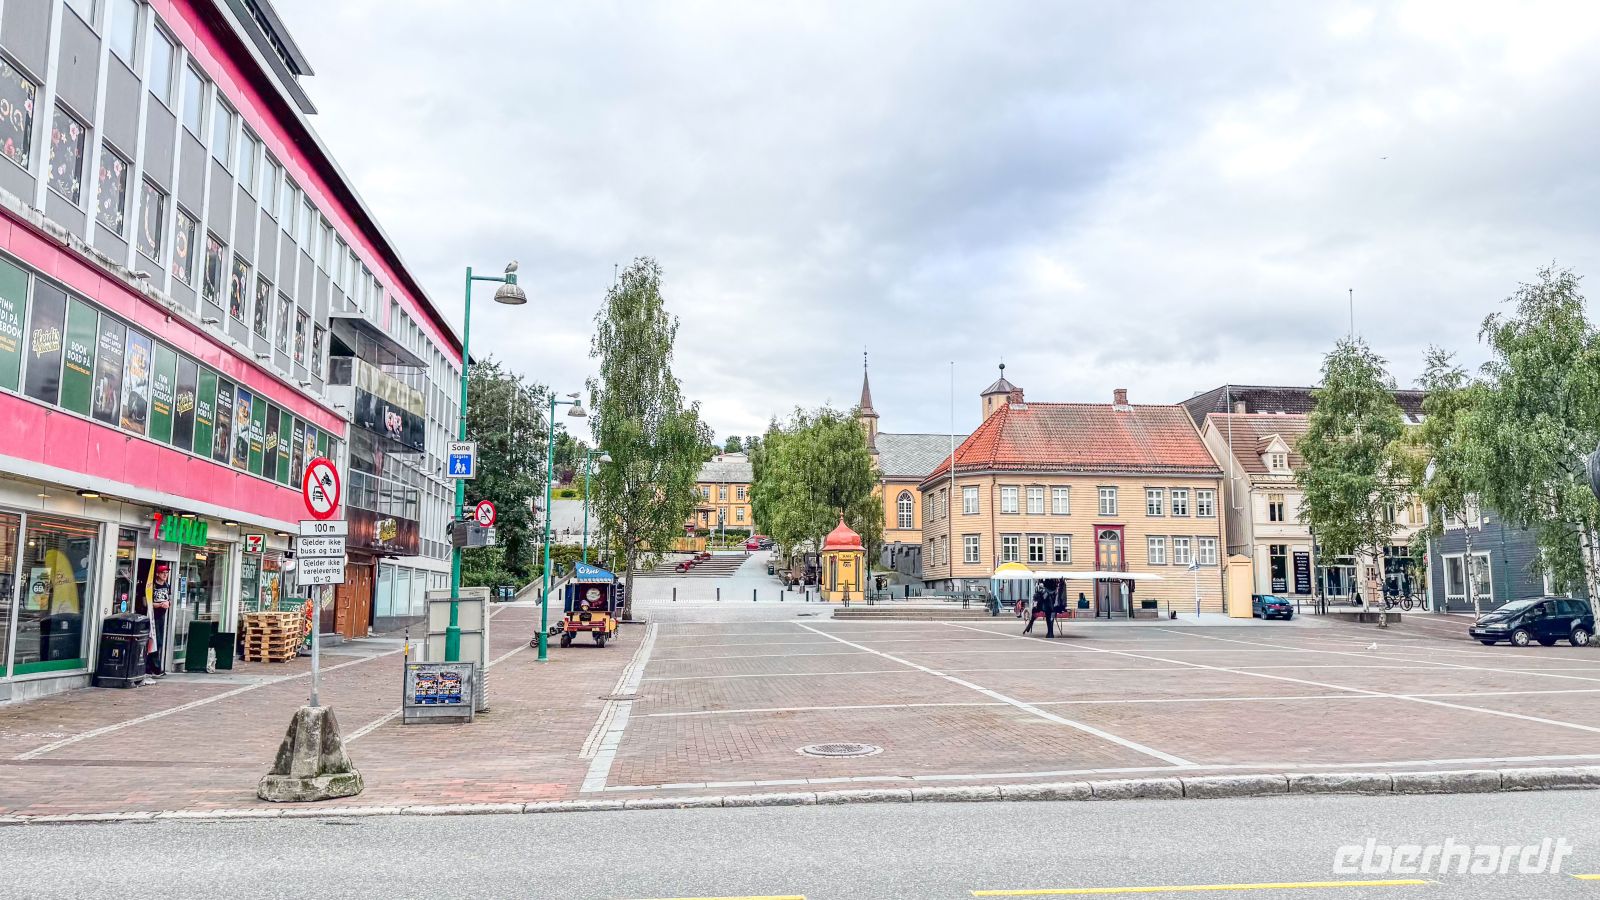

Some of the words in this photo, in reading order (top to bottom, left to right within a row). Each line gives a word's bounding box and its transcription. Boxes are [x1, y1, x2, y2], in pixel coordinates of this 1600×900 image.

[71, 341, 88, 356] BOOK
[67, 350, 82, 363] BORD
[314, 523, 328, 533] 100
[302, 539, 325, 547] Gjelder
[303, 567, 341, 575] varelevering
